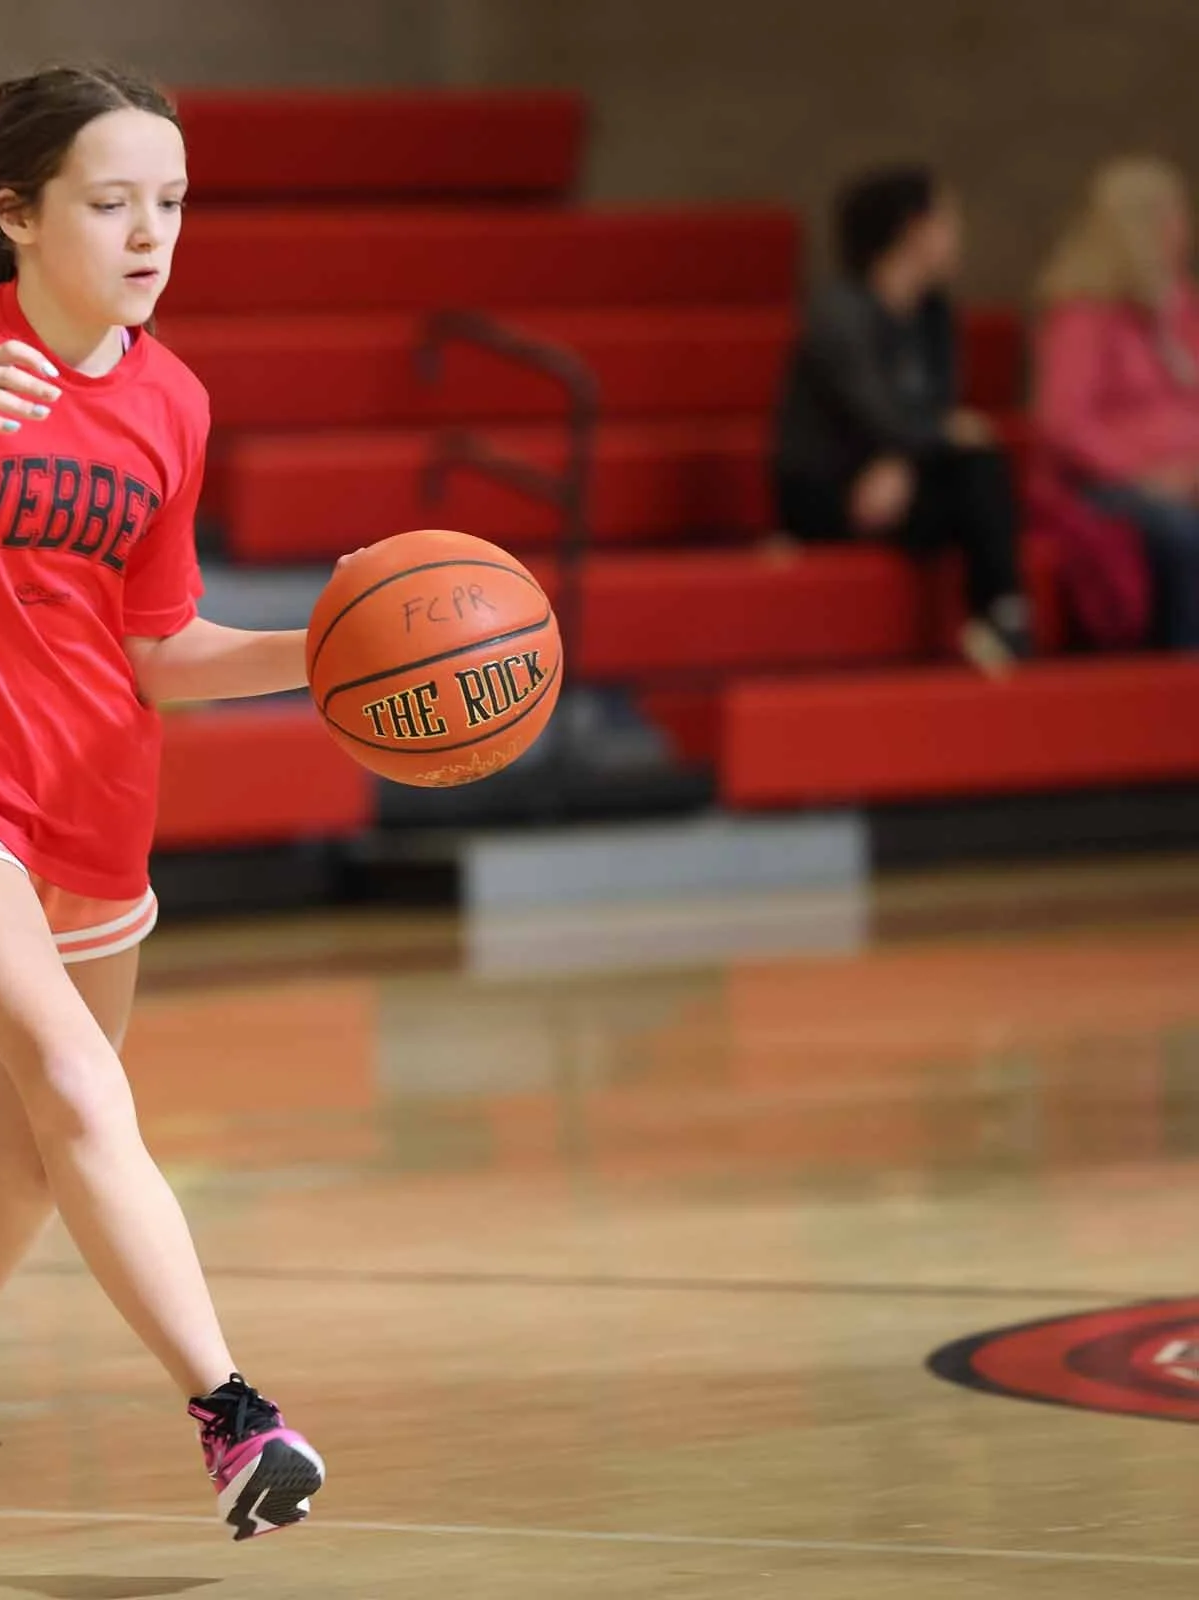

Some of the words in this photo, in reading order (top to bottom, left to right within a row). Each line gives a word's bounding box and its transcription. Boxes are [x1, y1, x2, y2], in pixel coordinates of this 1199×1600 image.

[402, 582, 497, 634] FCPR
[363, 680, 448, 739] THE
[454, 650, 548, 727] ROCK
